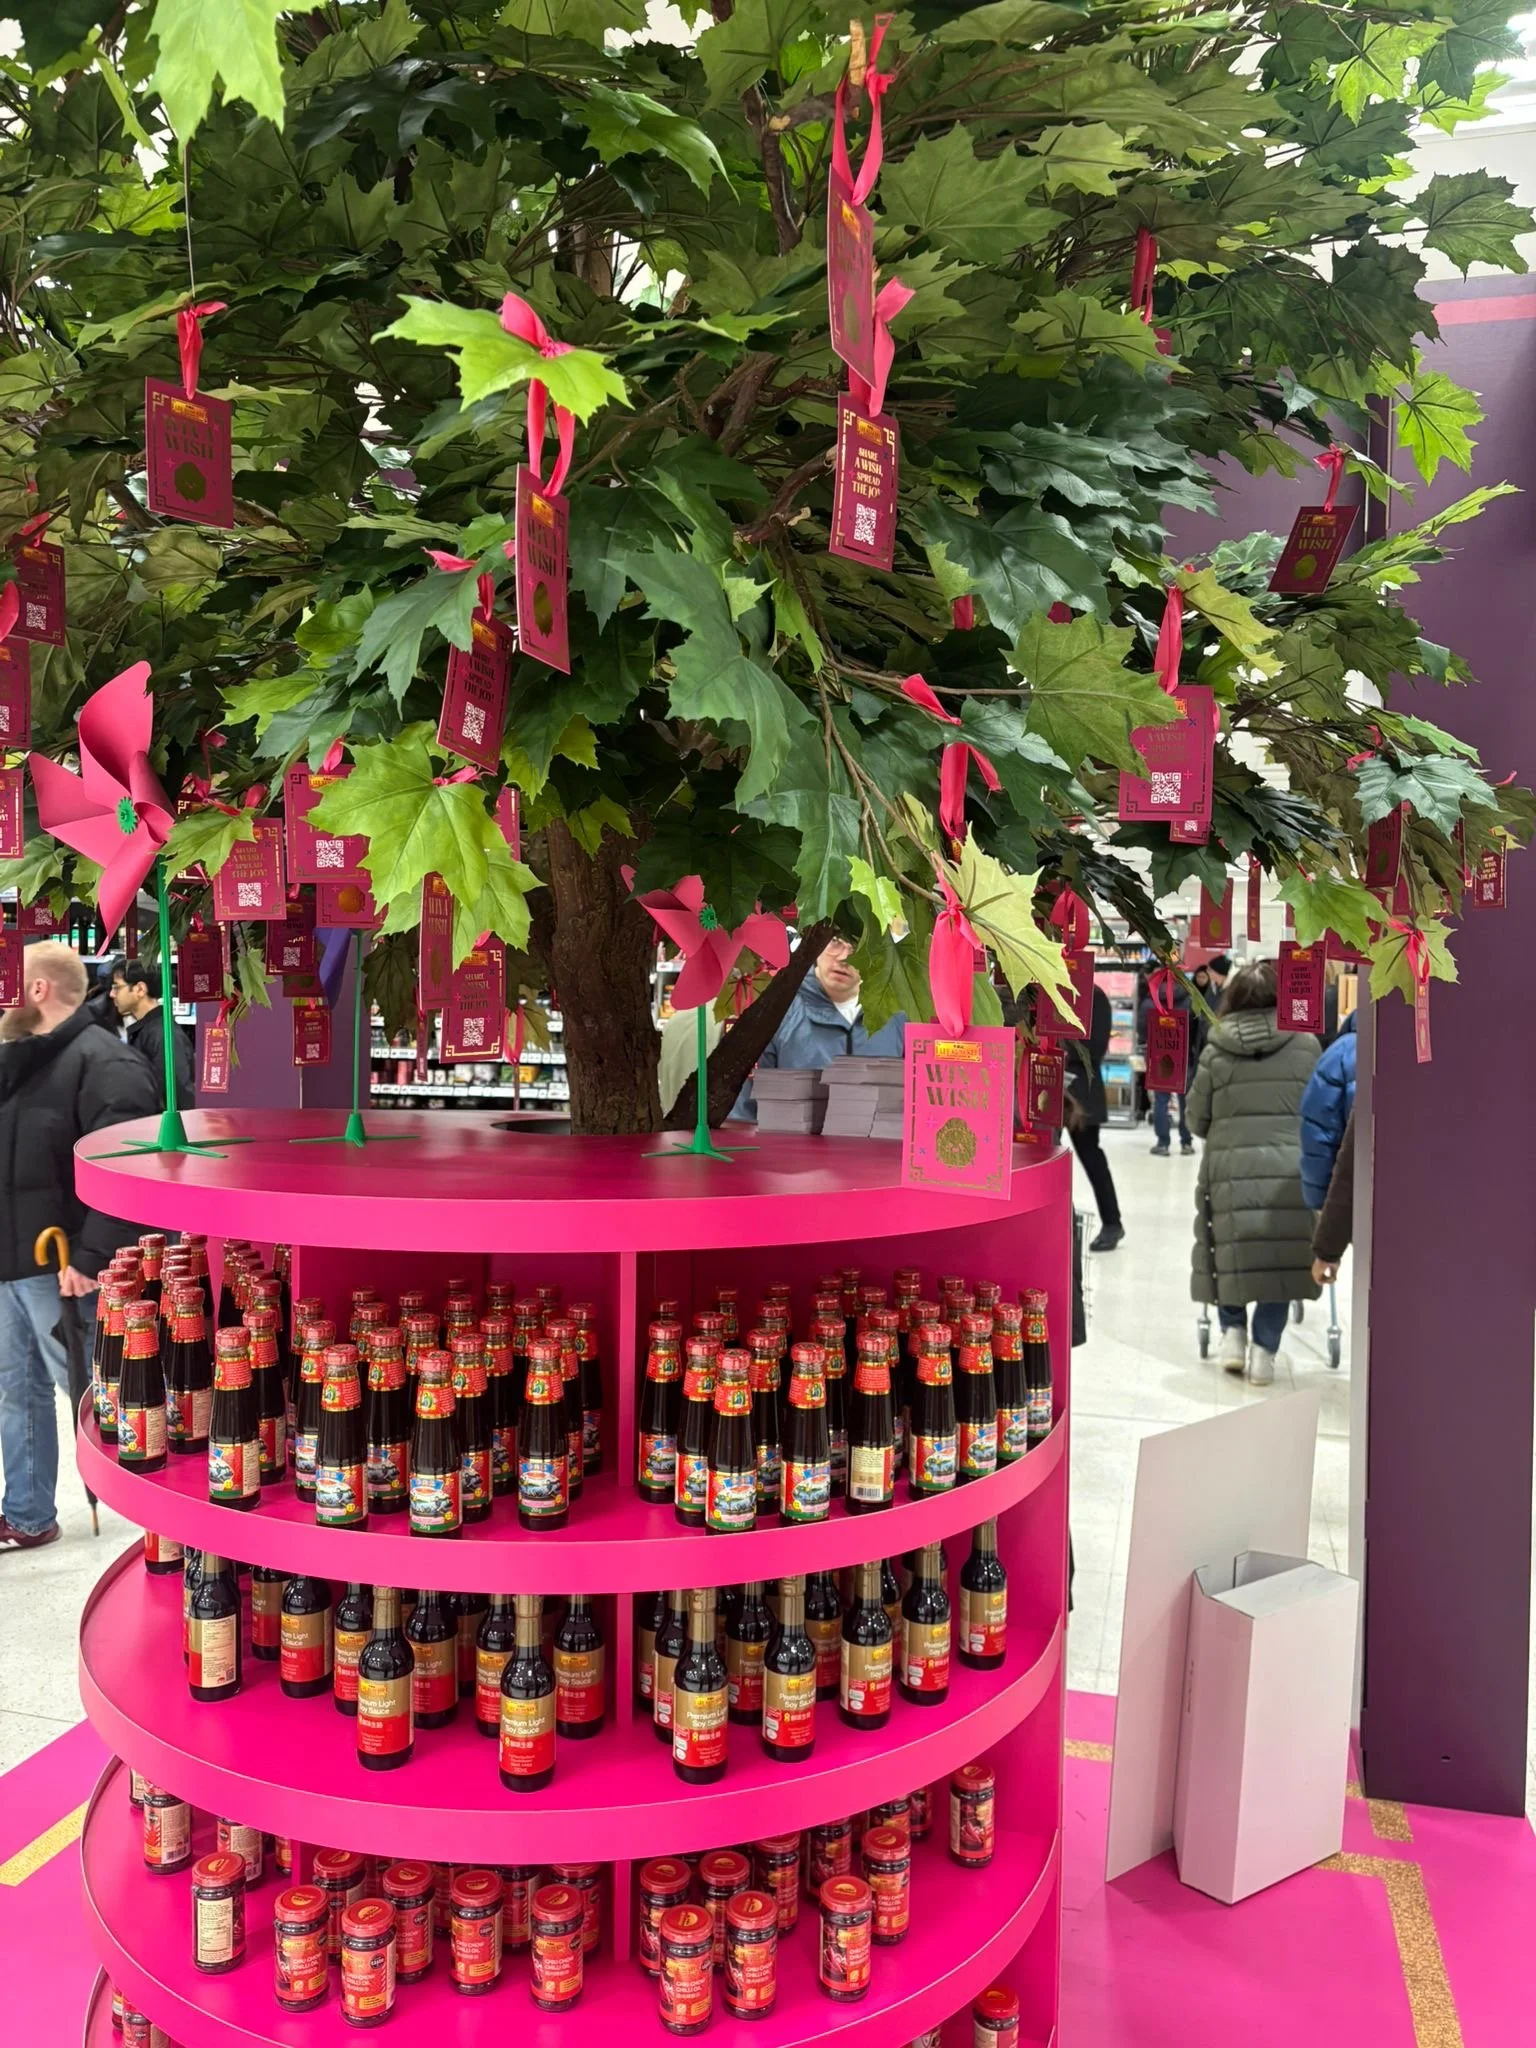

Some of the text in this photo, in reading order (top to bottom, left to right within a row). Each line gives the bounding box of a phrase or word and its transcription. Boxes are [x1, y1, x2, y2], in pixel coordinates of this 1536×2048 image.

[164, 432, 214, 461] WISH
[858, 448, 879, 462] SHARE
[854, 457, 861, 468] A
[857, 472, 881, 486] SPREAD
[852, 481, 868, 496] THE
[1298, 539, 1333, 549] WISH
[528, 544, 557, 577] WISH
[463, 680, 479, 695] THE
[926, 1064, 969, 1085] WIN
[926, 1086, 990, 1110] WISH
[293, 1633, 309, 1641] Light
[426, 1661, 442, 1669] Light
[581, 1669, 597, 1679] Light
[379, 1699, 397, 1709] Light
[784, 1701, 798, 1710] Soy
[370, 1707, 391, 1715] Sauce
[529, 1717, 546, 1729] Light
[692, 1718, 706, 1729] Soy
[505, 1724, 540, 1735] Soy Sauce
